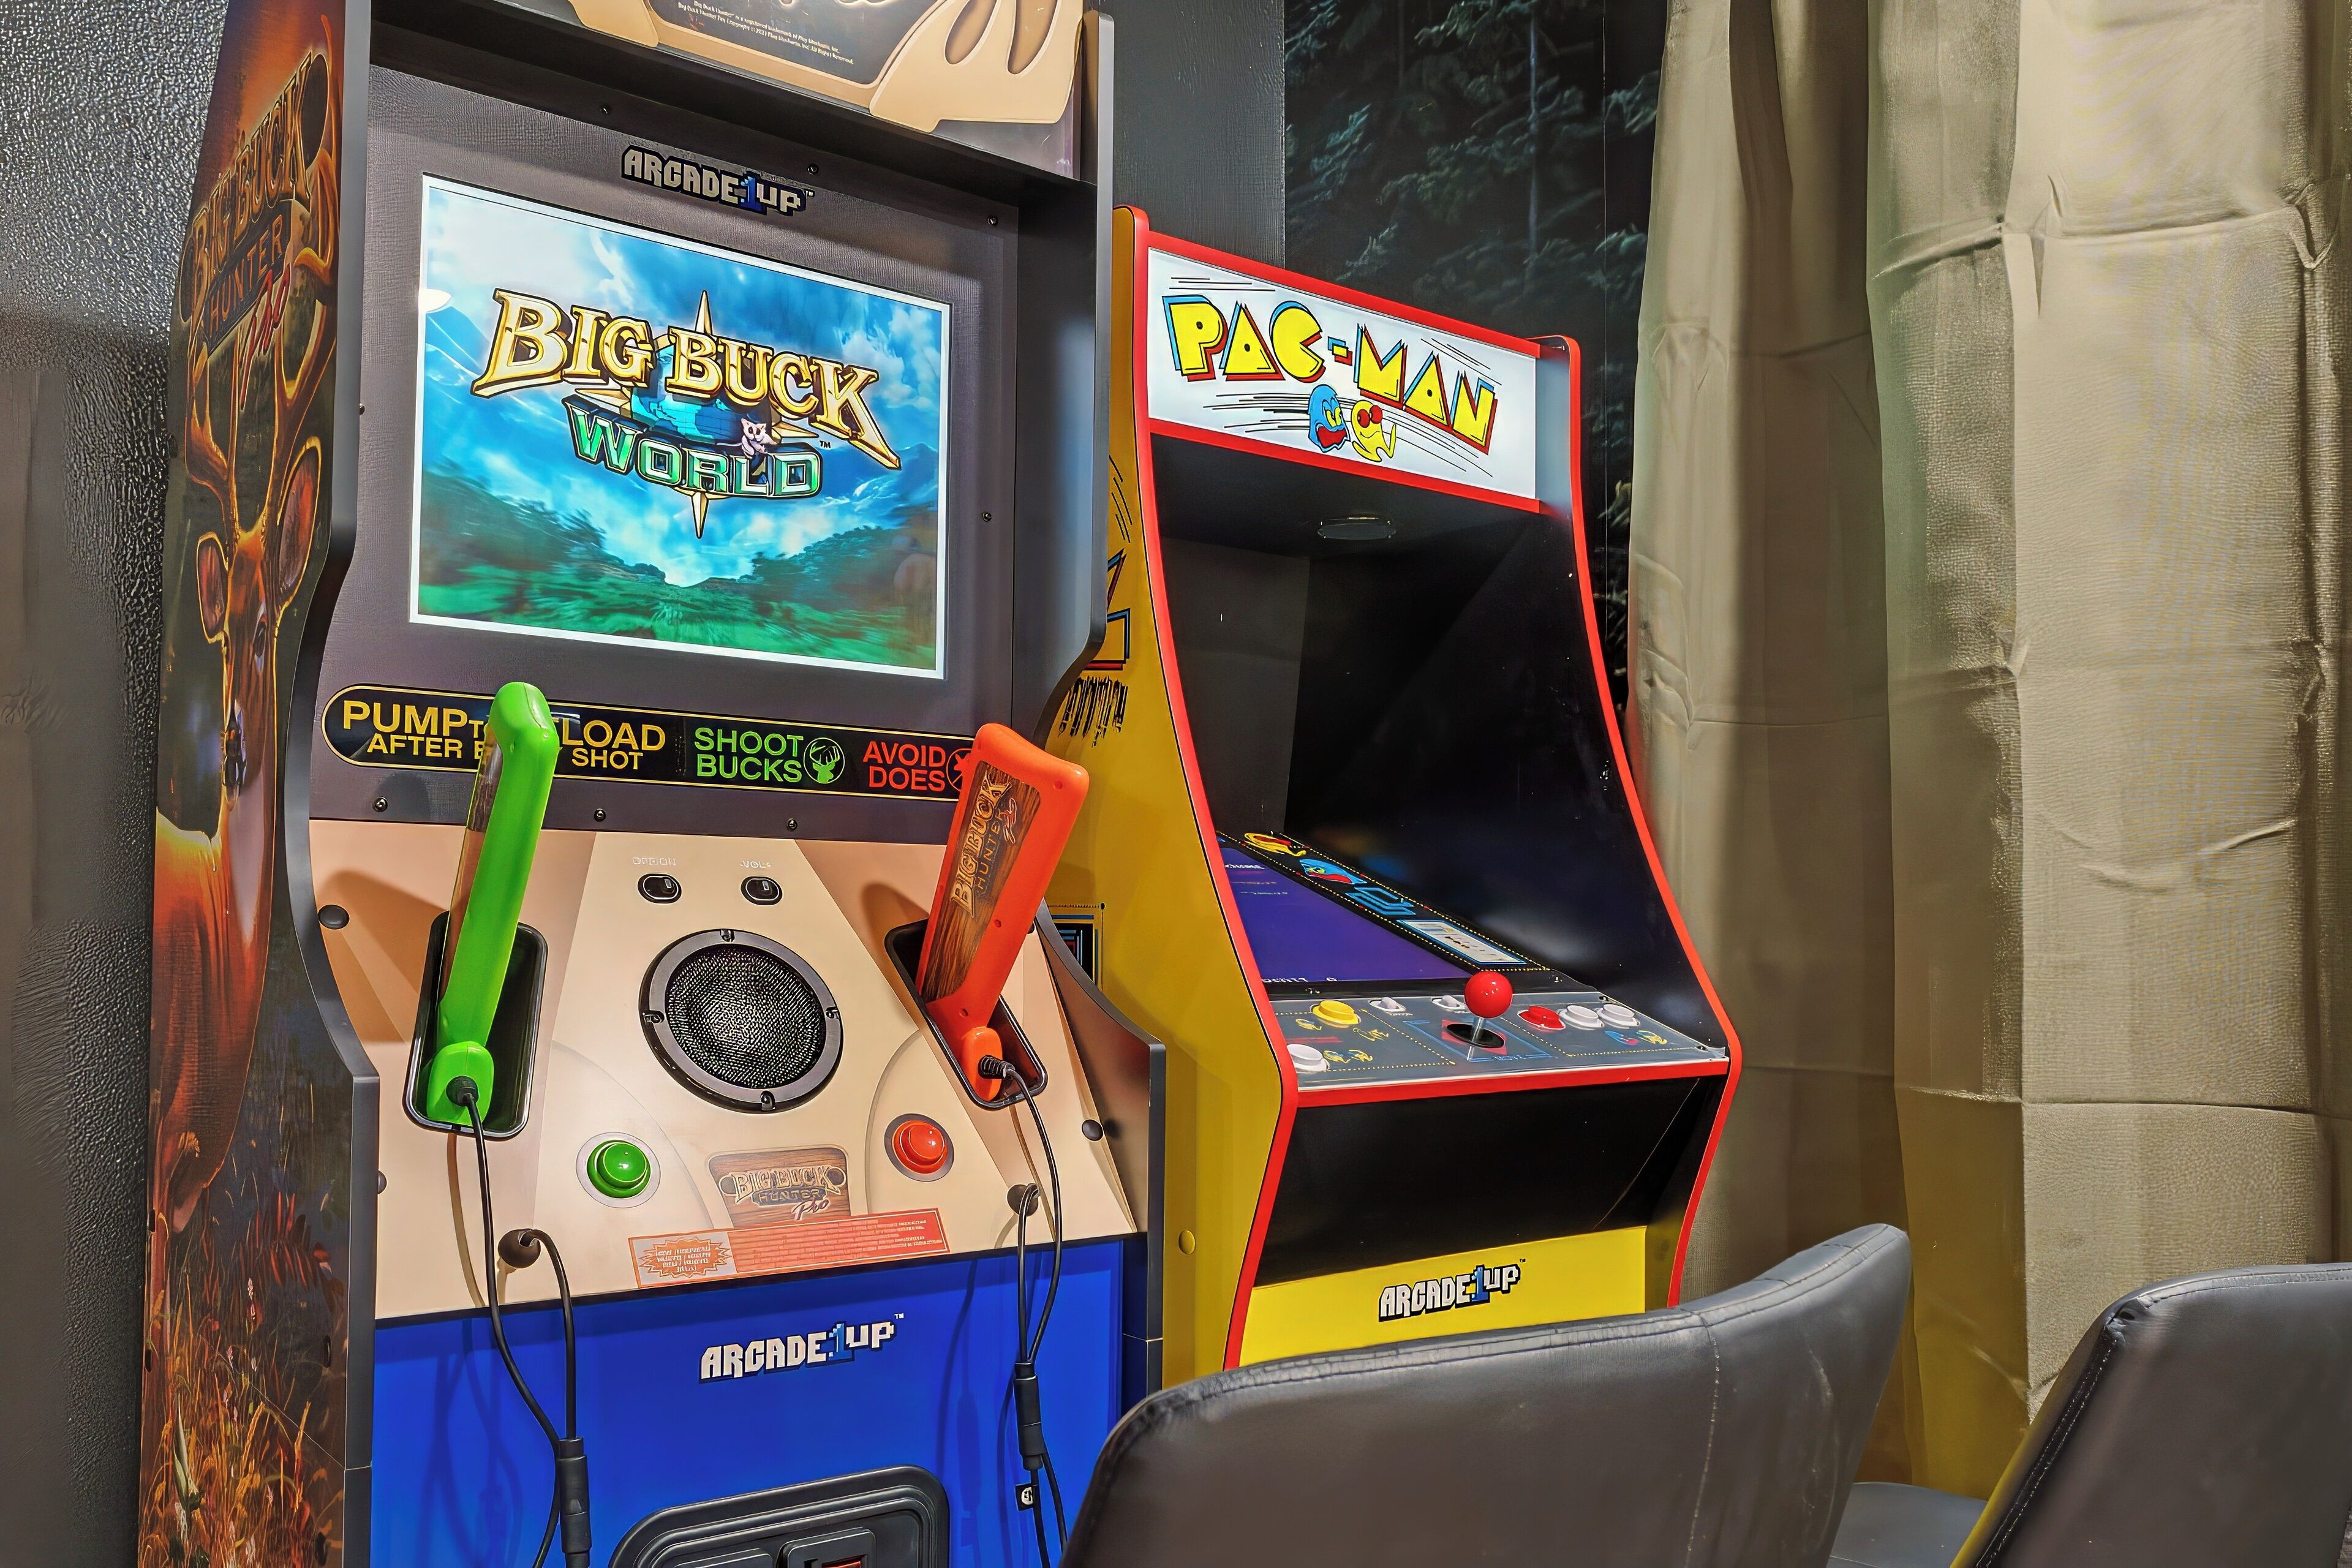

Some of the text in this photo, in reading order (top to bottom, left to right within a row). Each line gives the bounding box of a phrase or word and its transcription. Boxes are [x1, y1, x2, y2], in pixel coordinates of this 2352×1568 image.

[210, 214, 284, 335] HUNTER
[472, 288, 902, 470] BIG BUCK
[1162, 295, 1499, 454] PAC-MAN
[562, 393, 824, 498] WORLD
[343, 699, 469, 737] PUMP
[368, 733, 462, 759] AFTER
[571, 748, 644, 771] SHOT
[694, 726, 804, 758] SHOOT
[862, 741, 946, 767] AVOID
[696, 753, 803, 783] BUCKS
[869, 766, 946, 792] DOES
[774, 1165, 841, 1195] BUCK
[758, 1188, 821, 1205] HUNTER
[791, 1197, 831, 1221] Pro
